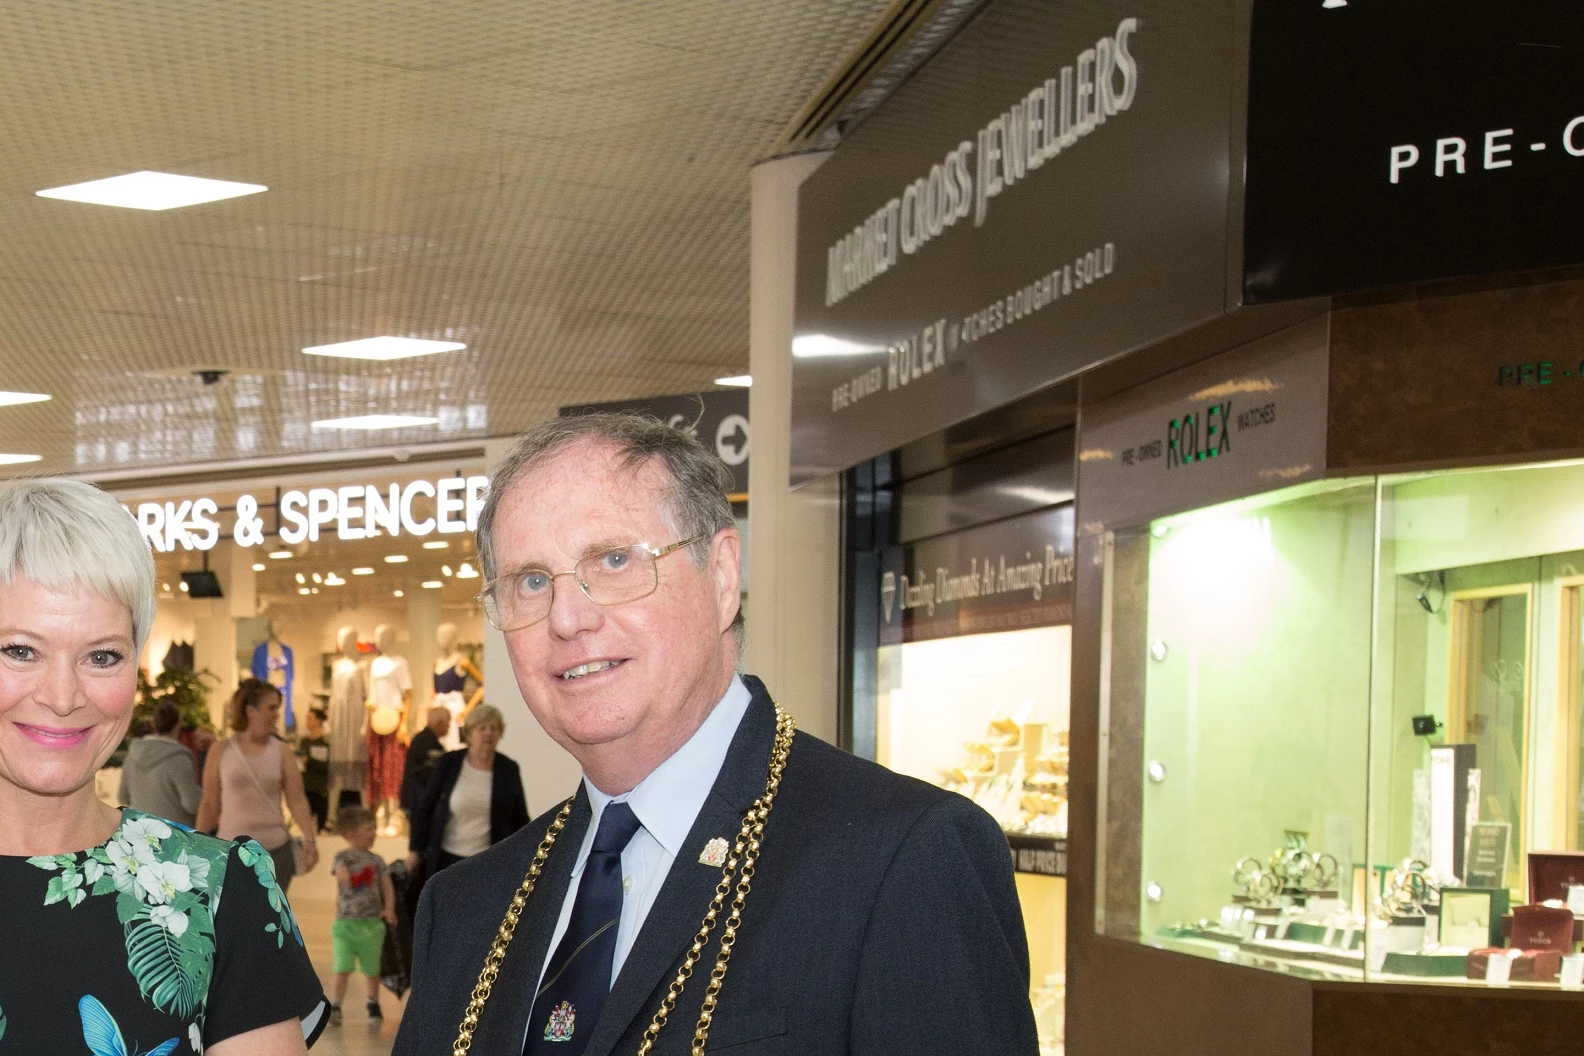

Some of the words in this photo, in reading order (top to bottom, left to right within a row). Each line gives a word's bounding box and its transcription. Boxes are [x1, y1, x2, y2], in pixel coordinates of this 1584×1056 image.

[900, 139, 973, 254] CROSS
[973, 17, 1138, 228] JEWELLERS
[887, 318, 948, 392] ROLEX
[949, 299, 1004, 351] WTCHES
[1074, 242, 1114, 290] SOLD
[1498, 360, 1584, 386] PRE-
[1167, 400, 1232, 470] ROLEX
[121, 498, 219, 552] RKS
[233, 494, 264, 548] &
[936, 556, 981, 604] Diamonds
